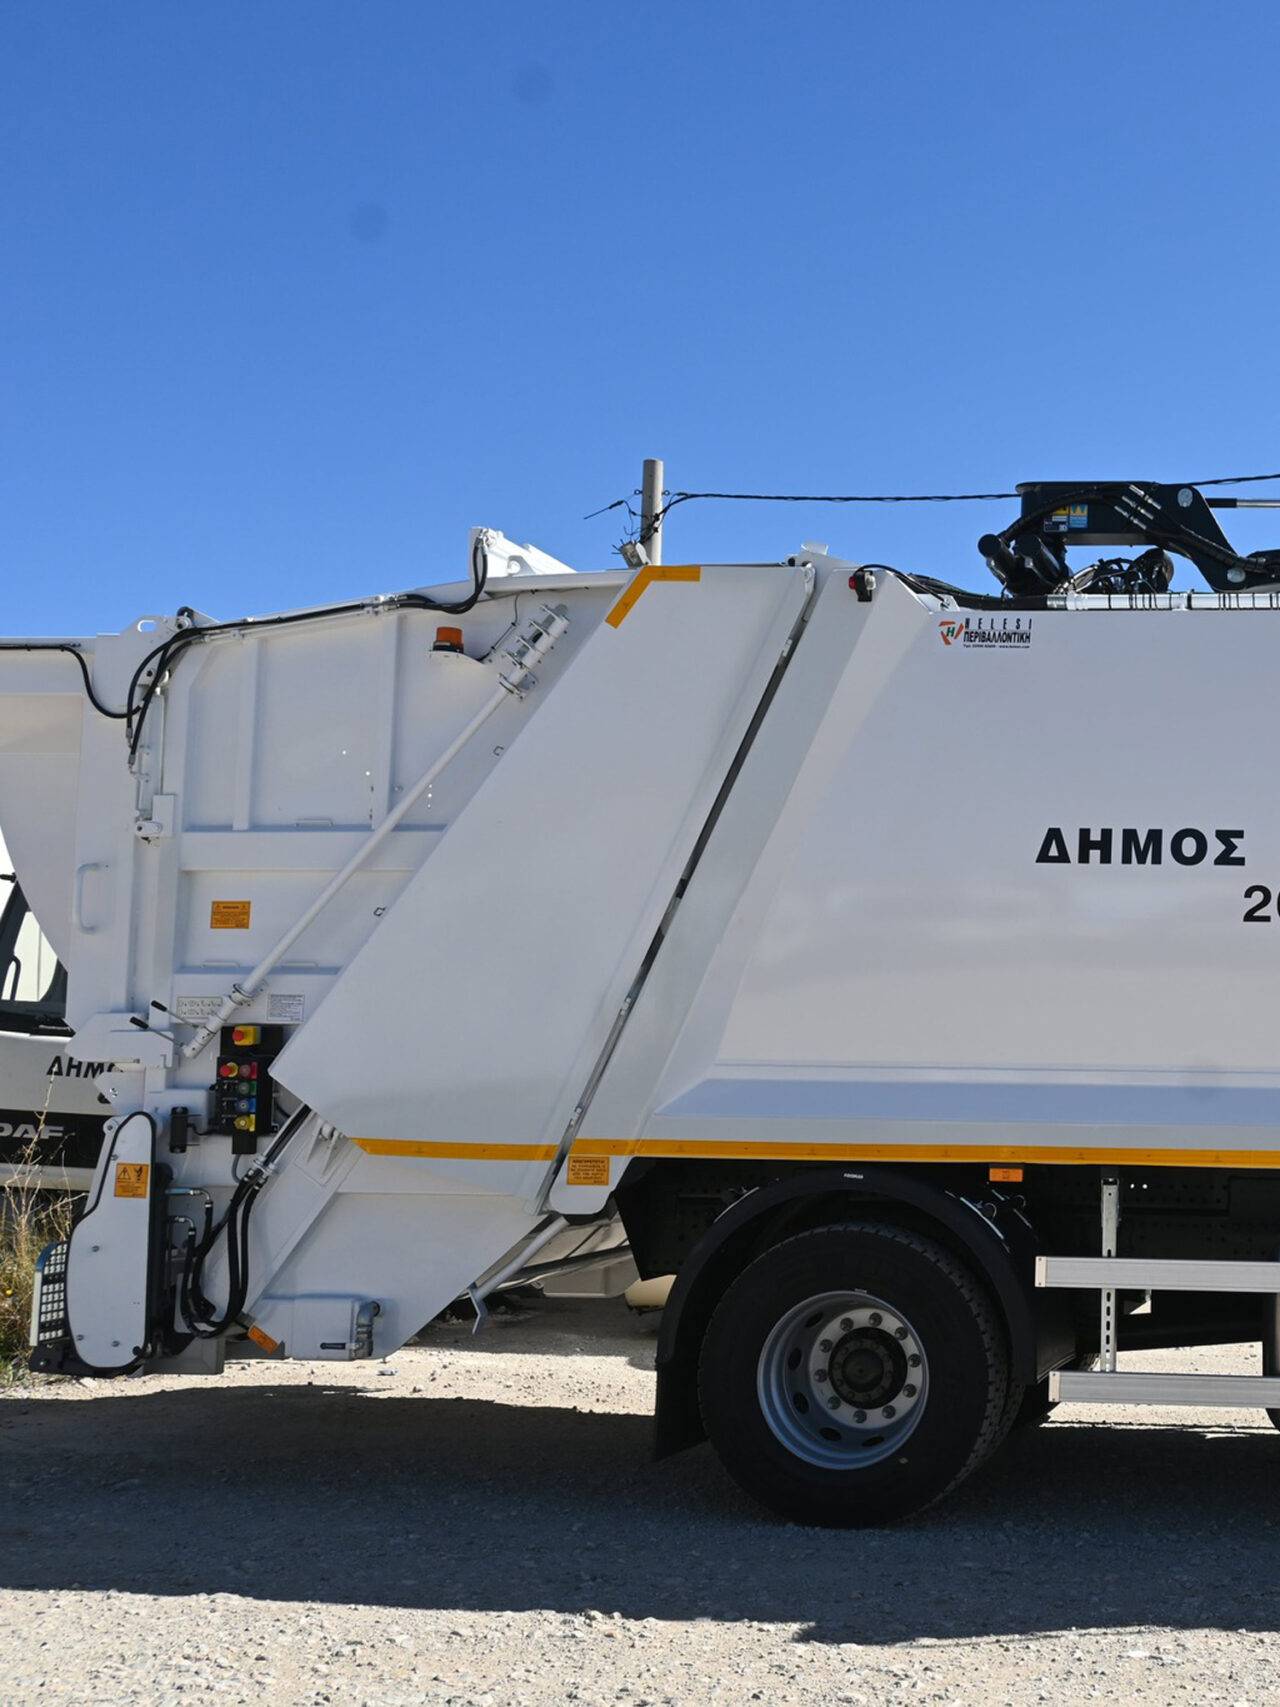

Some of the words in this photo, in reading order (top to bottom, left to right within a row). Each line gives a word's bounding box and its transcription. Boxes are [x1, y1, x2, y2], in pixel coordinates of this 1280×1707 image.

[965, 617, 1032, 630] HELESI
[963, 630, 1031, 643] ΠΕΡΙΒΑΛΛΟΝΤΙΚΗ
[1035, 827, 1246, 866] ΔΗΜΟΣ
[46, 1055, 122, 1079] ΔΗΜ
